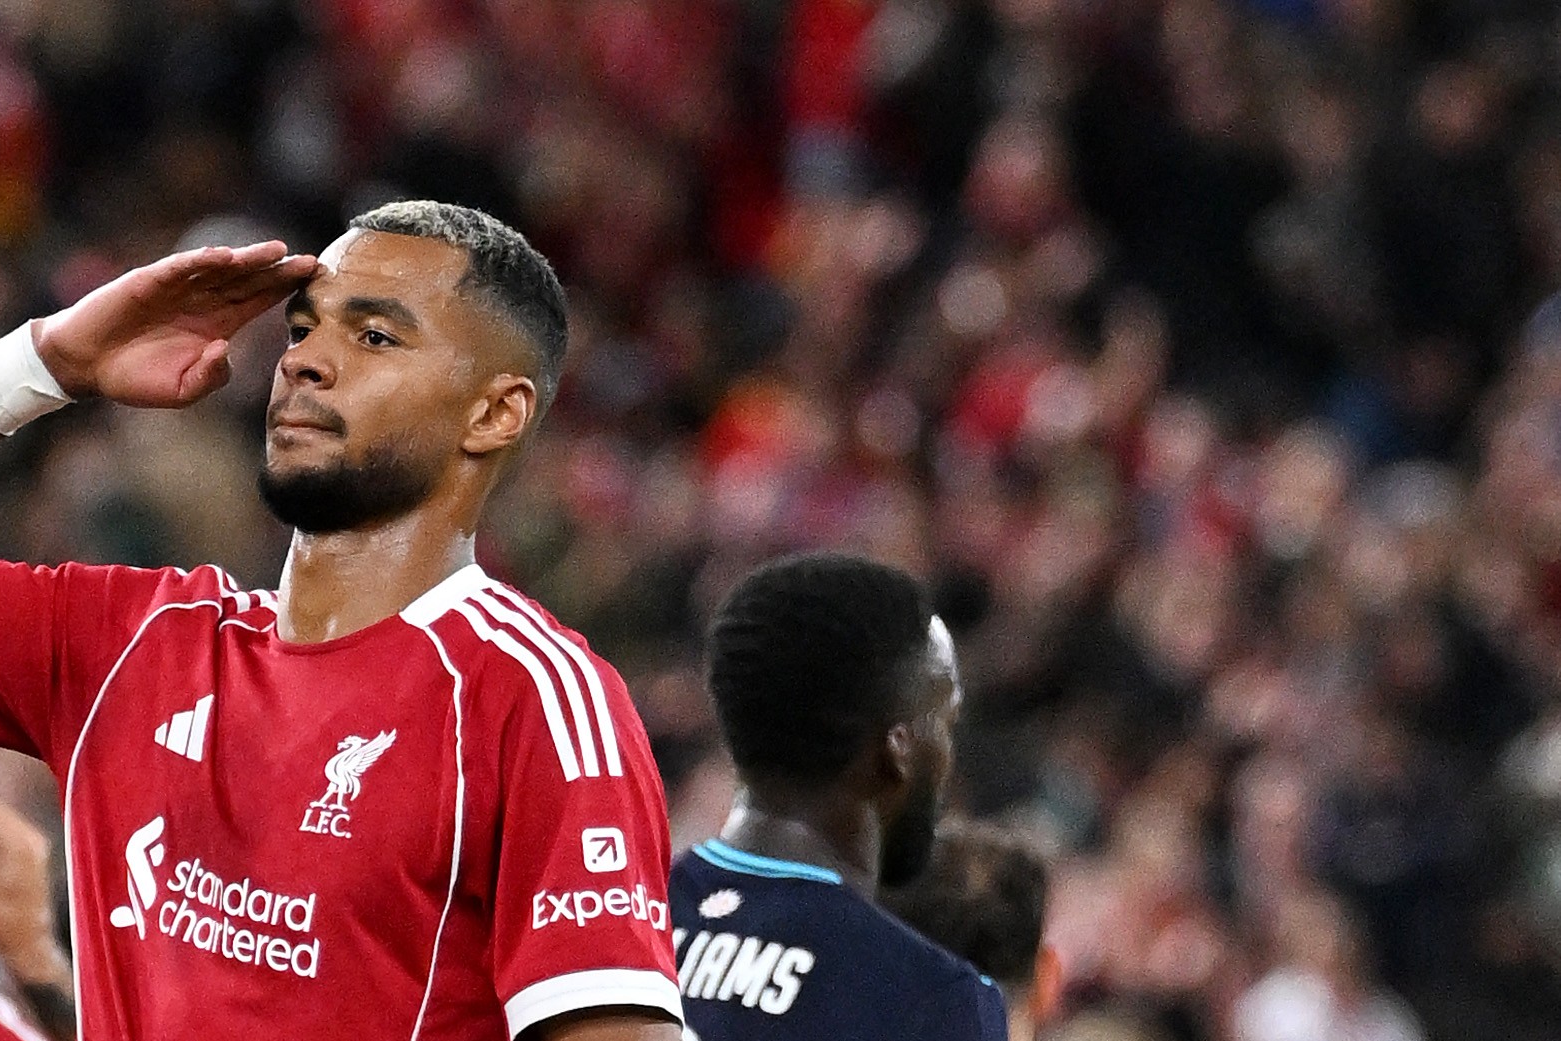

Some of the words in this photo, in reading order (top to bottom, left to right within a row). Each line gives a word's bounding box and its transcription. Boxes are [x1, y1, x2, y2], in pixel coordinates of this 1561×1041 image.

[166, 858, 316, 932] standard
[532, 883, 667, 931] Expeda
[158, 898, 321, 979] chartered
